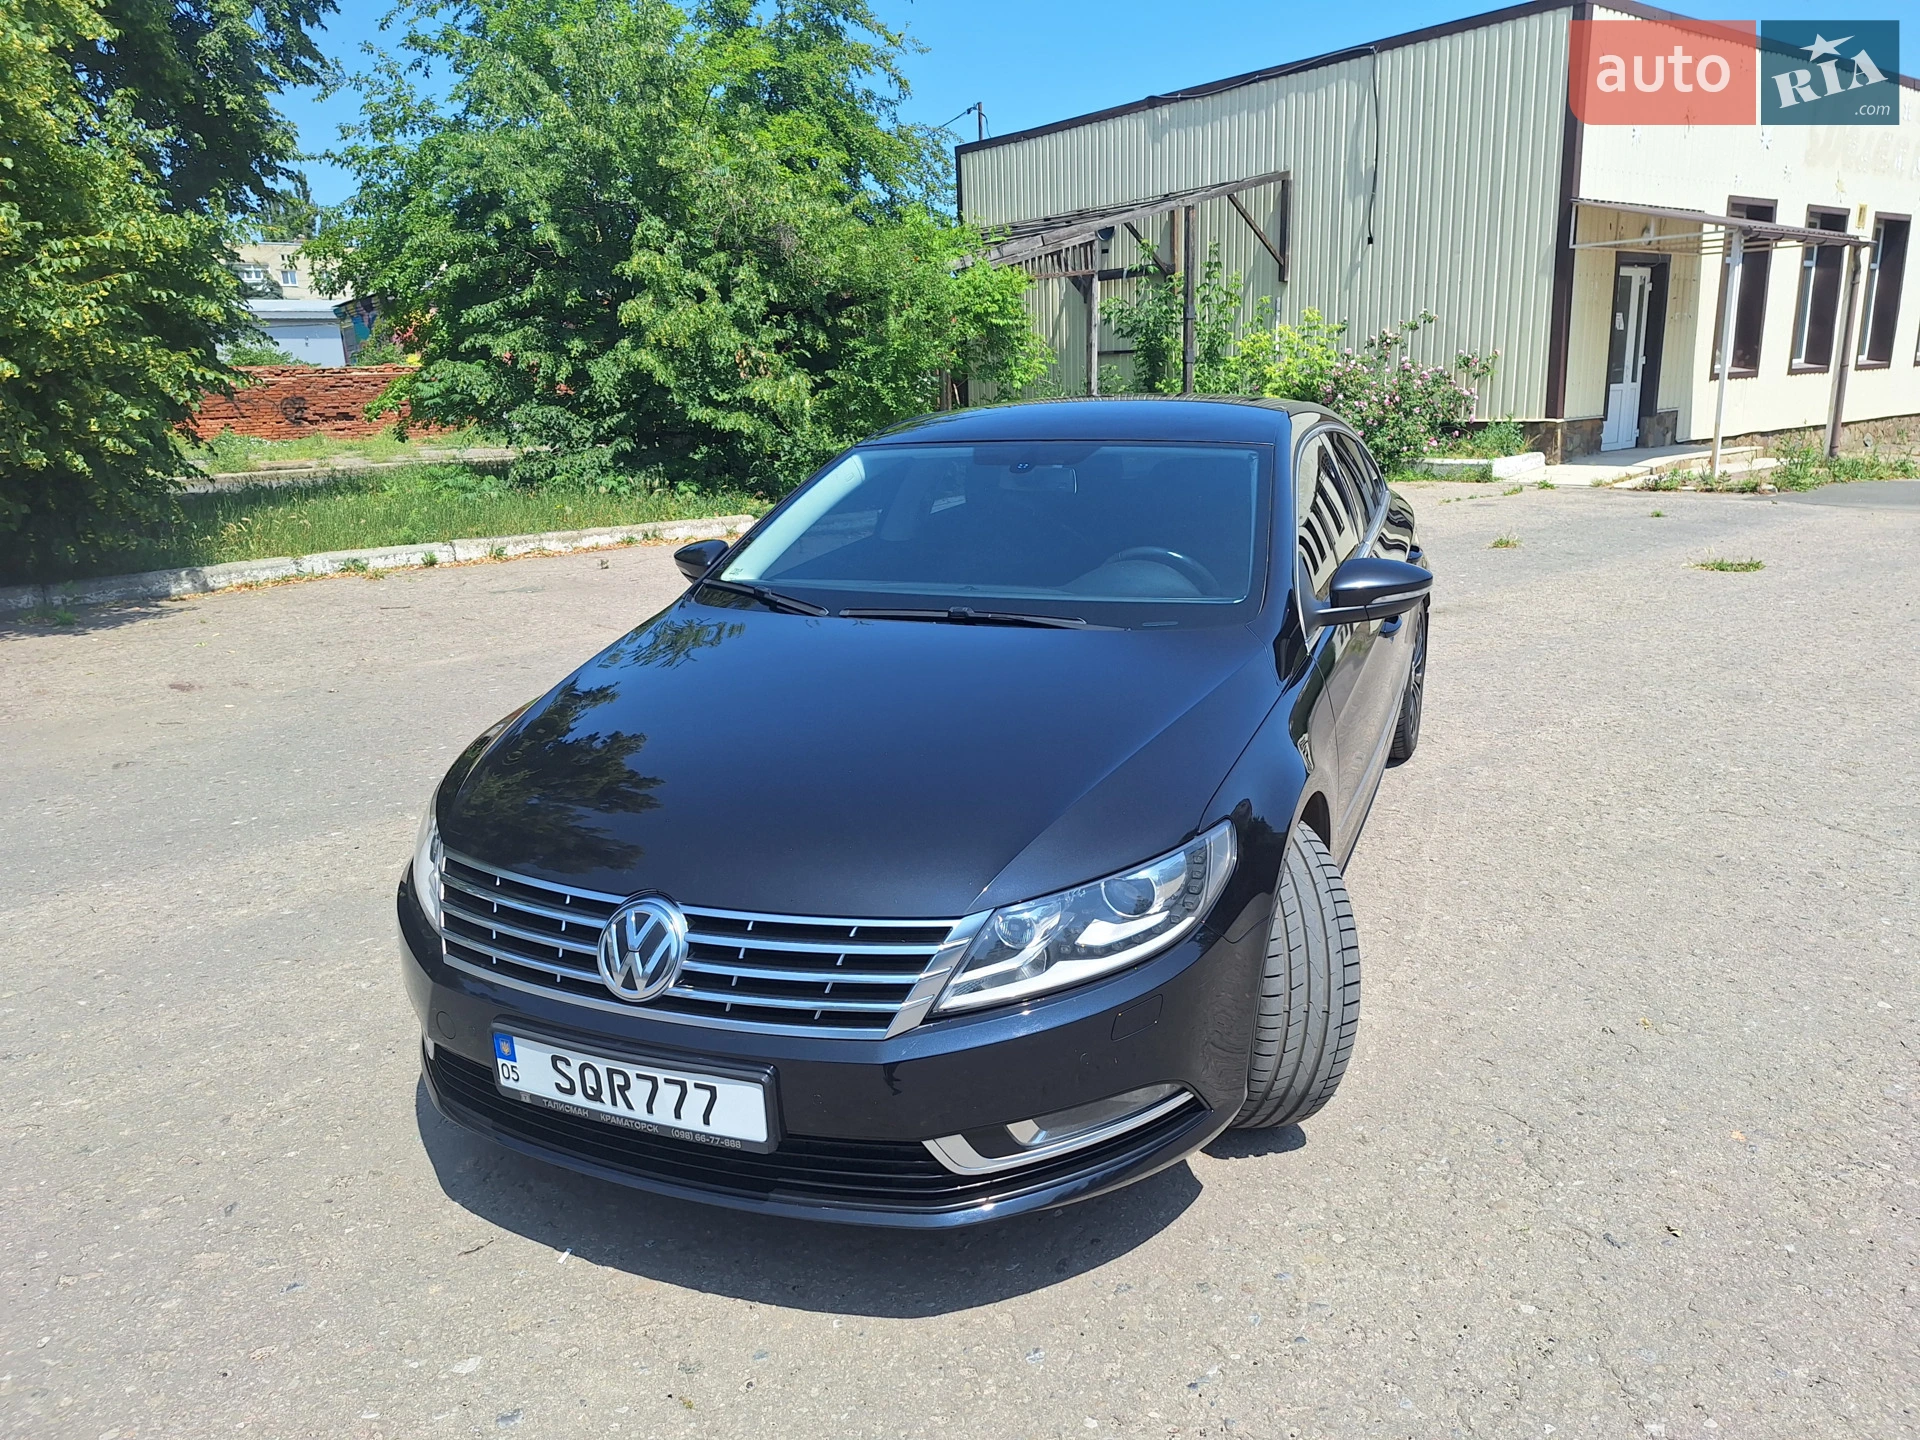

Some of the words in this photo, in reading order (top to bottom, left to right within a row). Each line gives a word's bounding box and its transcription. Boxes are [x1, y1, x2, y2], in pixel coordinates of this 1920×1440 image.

[501, 1062, 520, 1082] 05
[550, 1054, 718, 1126] SQR777
[542, 1098, 589, 1117] ТАЛИСМАН
[600, 1112, 659, 1133] КРАМАТОРСК
[671, 1127, 694, 1141] (098)
